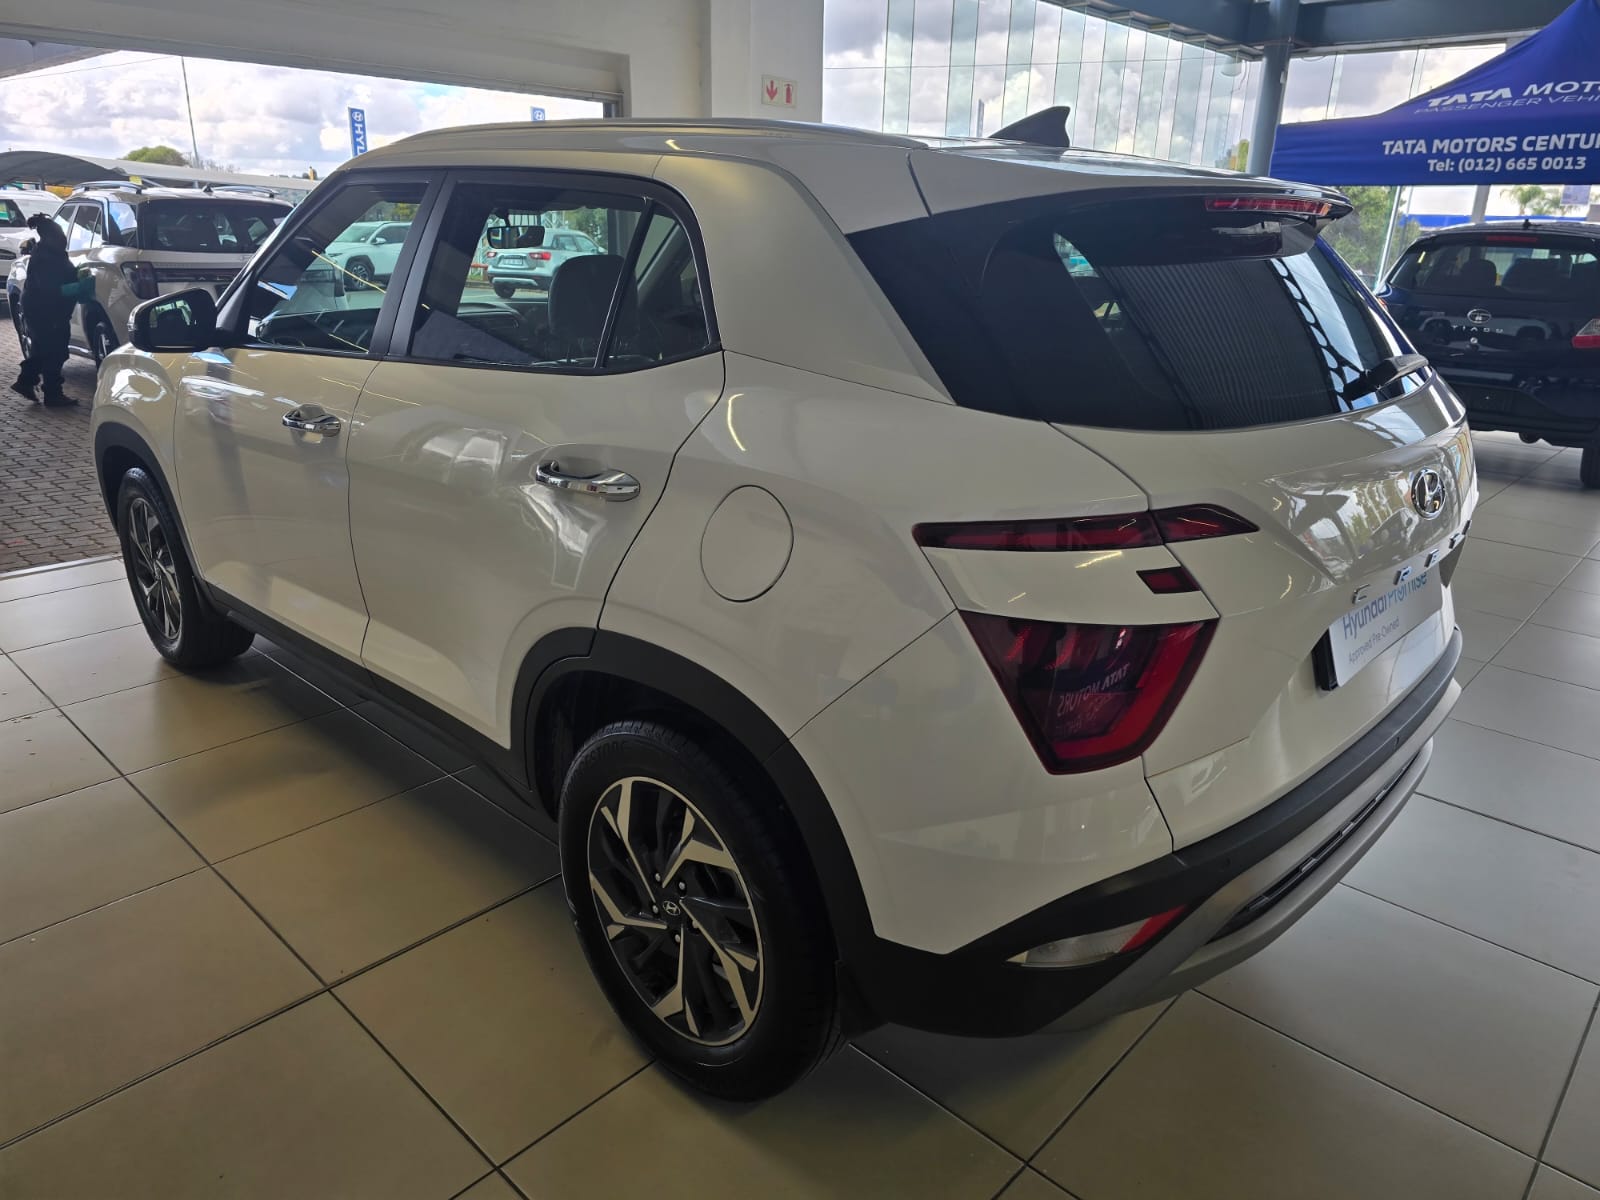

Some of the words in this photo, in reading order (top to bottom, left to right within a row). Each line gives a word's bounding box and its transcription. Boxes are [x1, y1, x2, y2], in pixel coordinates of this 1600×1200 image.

[1428, 88, 1512, 108] TATA
[1523, 81, 1600, 96] MOT
[1414, 97, 1542, 114] PASSENGER
[1382, 138, 1427, 156] TATA
[1432, 135, 1518, 153] MOTORS
[1428, 159, 1454, 172] Tel:
[1458, 157, 1502, 173] (012)
[1505, 157, 1538, 171] 665
[1541, 156, 1587, 171] 0013
[1351, 520, 1472, 604] CRET
